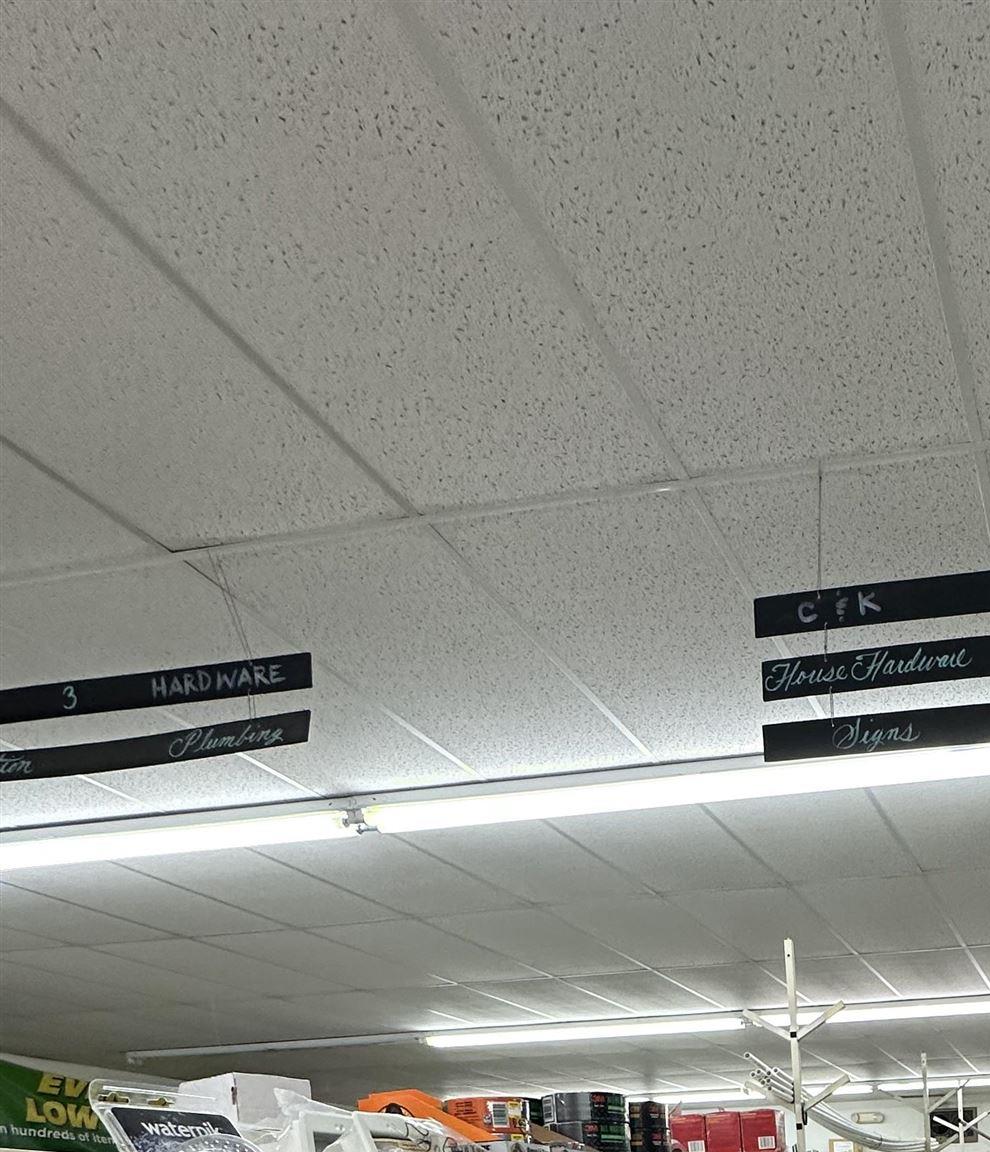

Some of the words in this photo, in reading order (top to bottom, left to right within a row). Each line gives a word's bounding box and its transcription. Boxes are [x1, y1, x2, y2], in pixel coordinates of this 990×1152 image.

[797, 601, 818, 624] C
[858, 591, 882, 616] K
[765, 661, 848, 692] House
[851, 648, 973, 682] Hardware
[62, 686, 77, 710] 3
[151, 664, 287, 698] HARDWARE
[169, 725, 284, 758] Plumbing
[832, 718, 920, 752] Signs
[25, 1097, 99, 1130] LOW
[11, 1124, 76, 1140] hundreds
[79, 1132, 91, 1142] of
